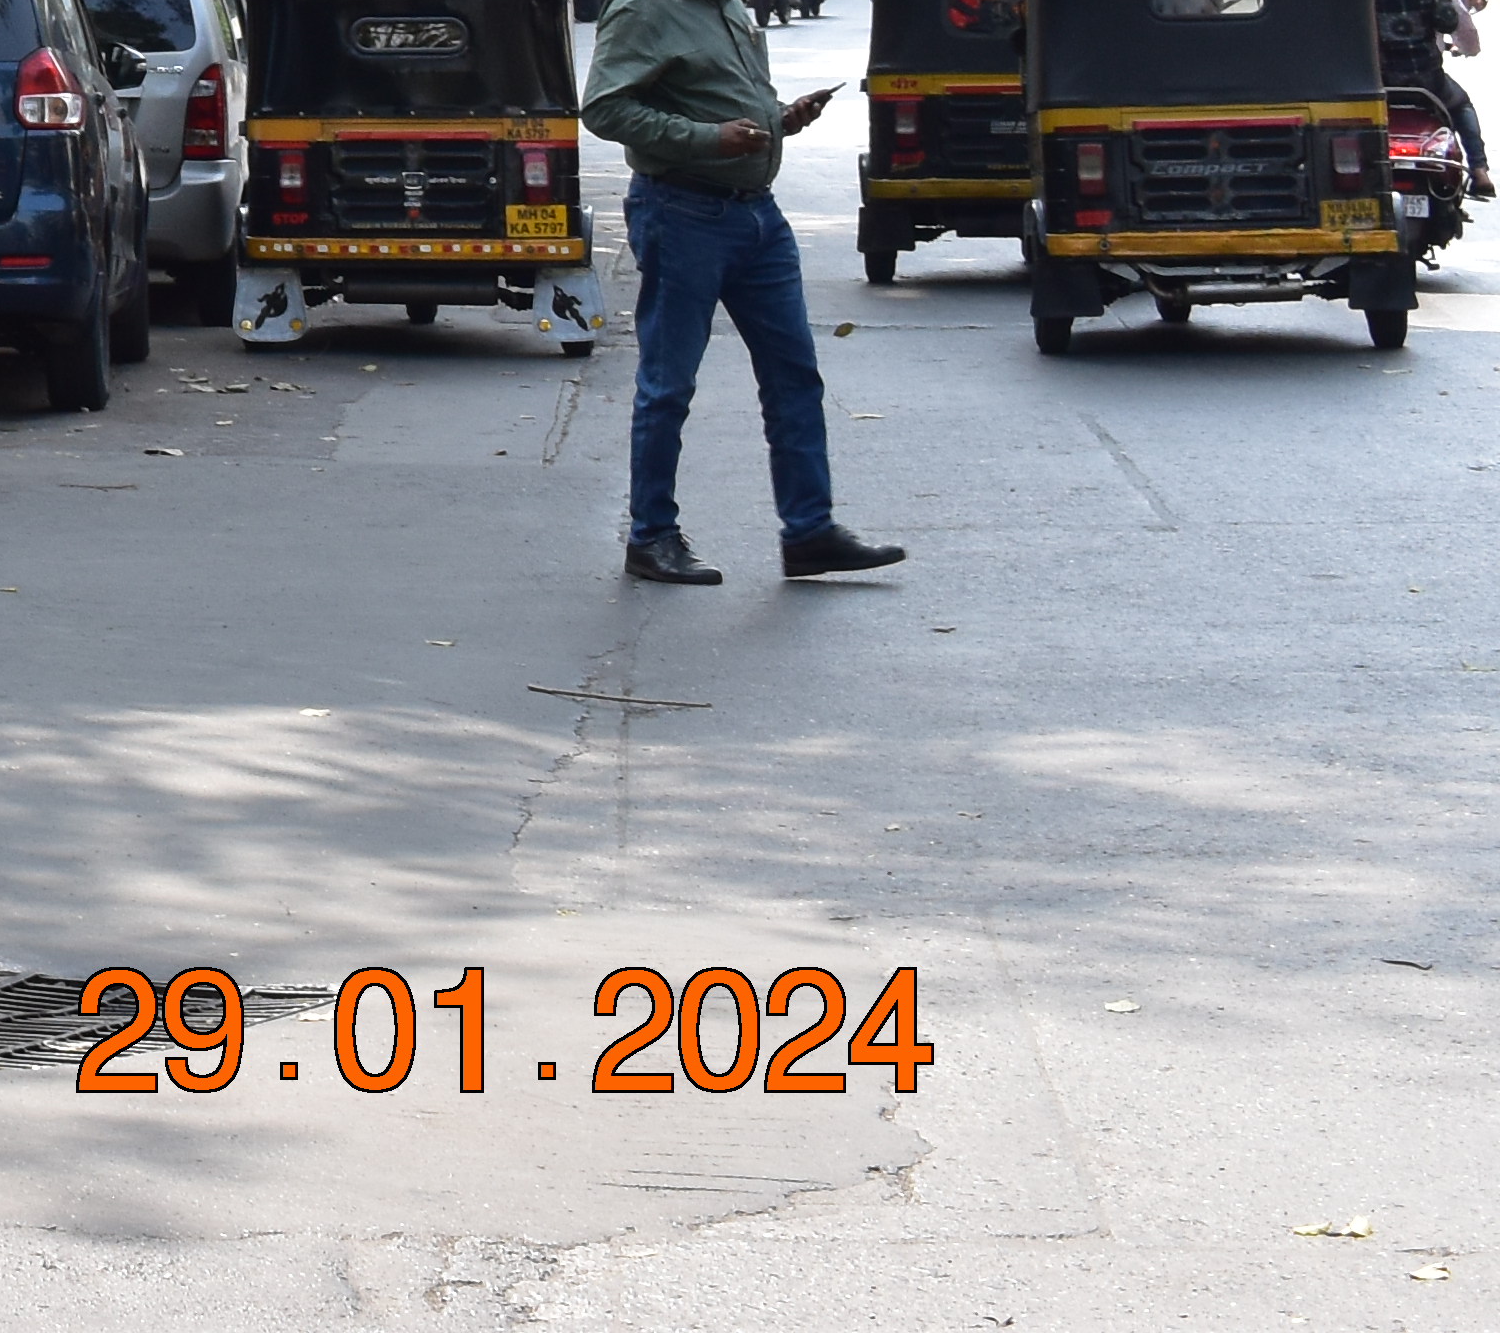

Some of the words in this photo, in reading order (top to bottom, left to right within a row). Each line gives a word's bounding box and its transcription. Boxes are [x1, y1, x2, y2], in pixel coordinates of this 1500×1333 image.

[272, 212, 309, 224] STOP
[516, 209, 537, 221] MH
[539, 209, 557, 221] 04
[509, 222, 530, 235] KA
[534, 222, 565, 235] 5797
